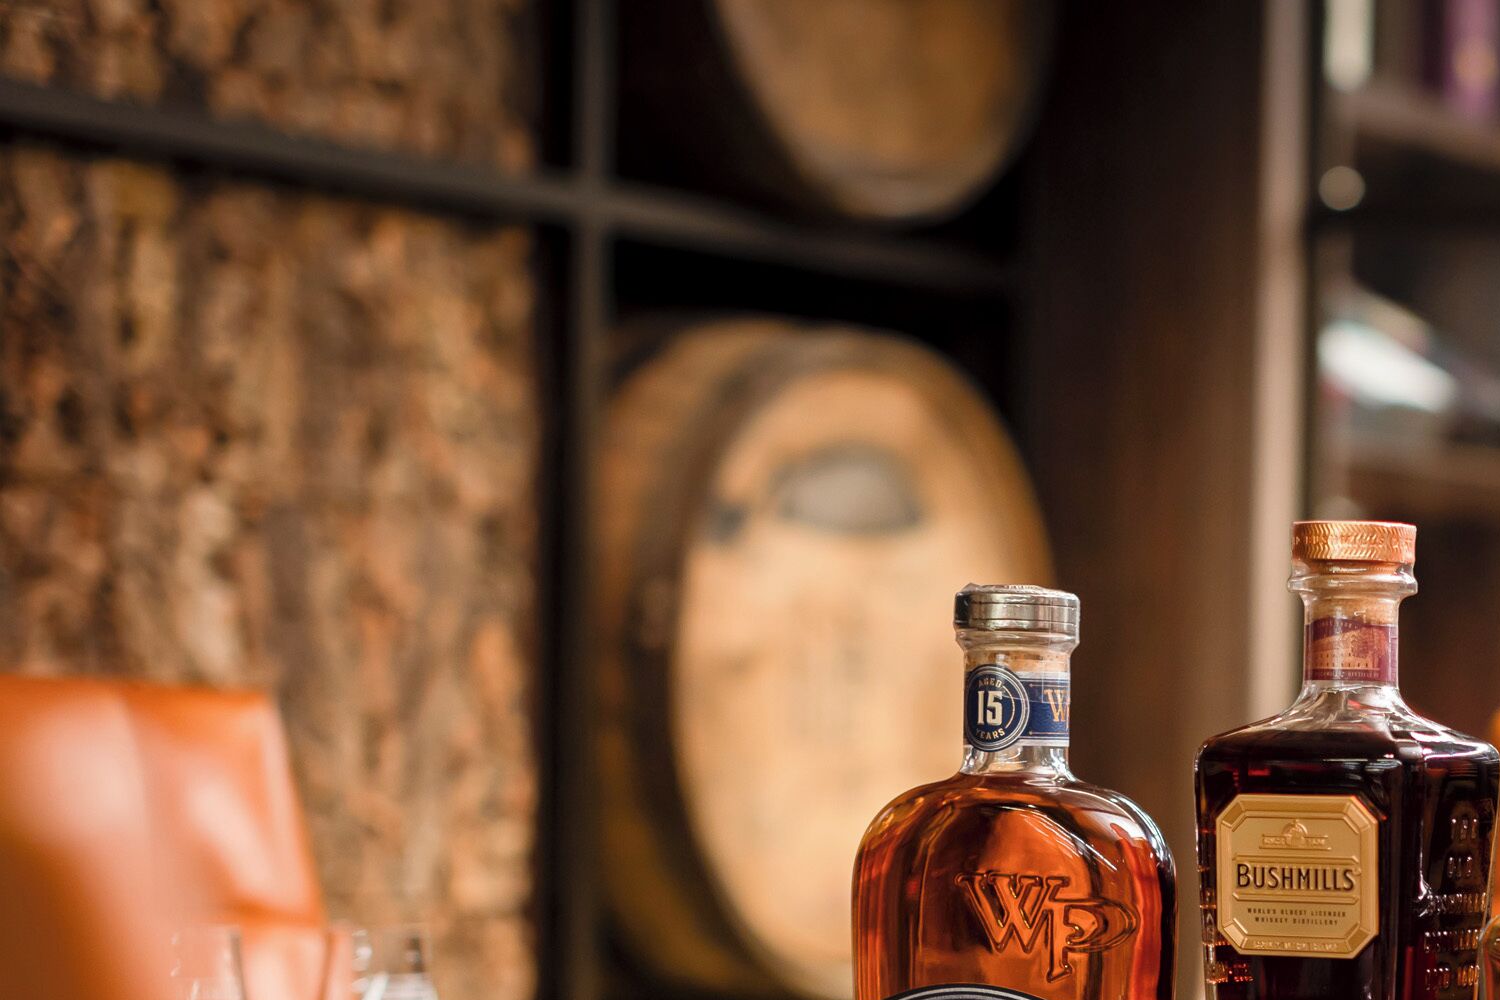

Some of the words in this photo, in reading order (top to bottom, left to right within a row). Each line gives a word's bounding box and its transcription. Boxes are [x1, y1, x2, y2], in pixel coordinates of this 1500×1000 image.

[979, 677, 1003, 689] AGED
[977, 690, 1003, 726] 15
[975, 728, 1006, 740] YEARS
[1236, 862, 1355, 892] BUSHMILLS
